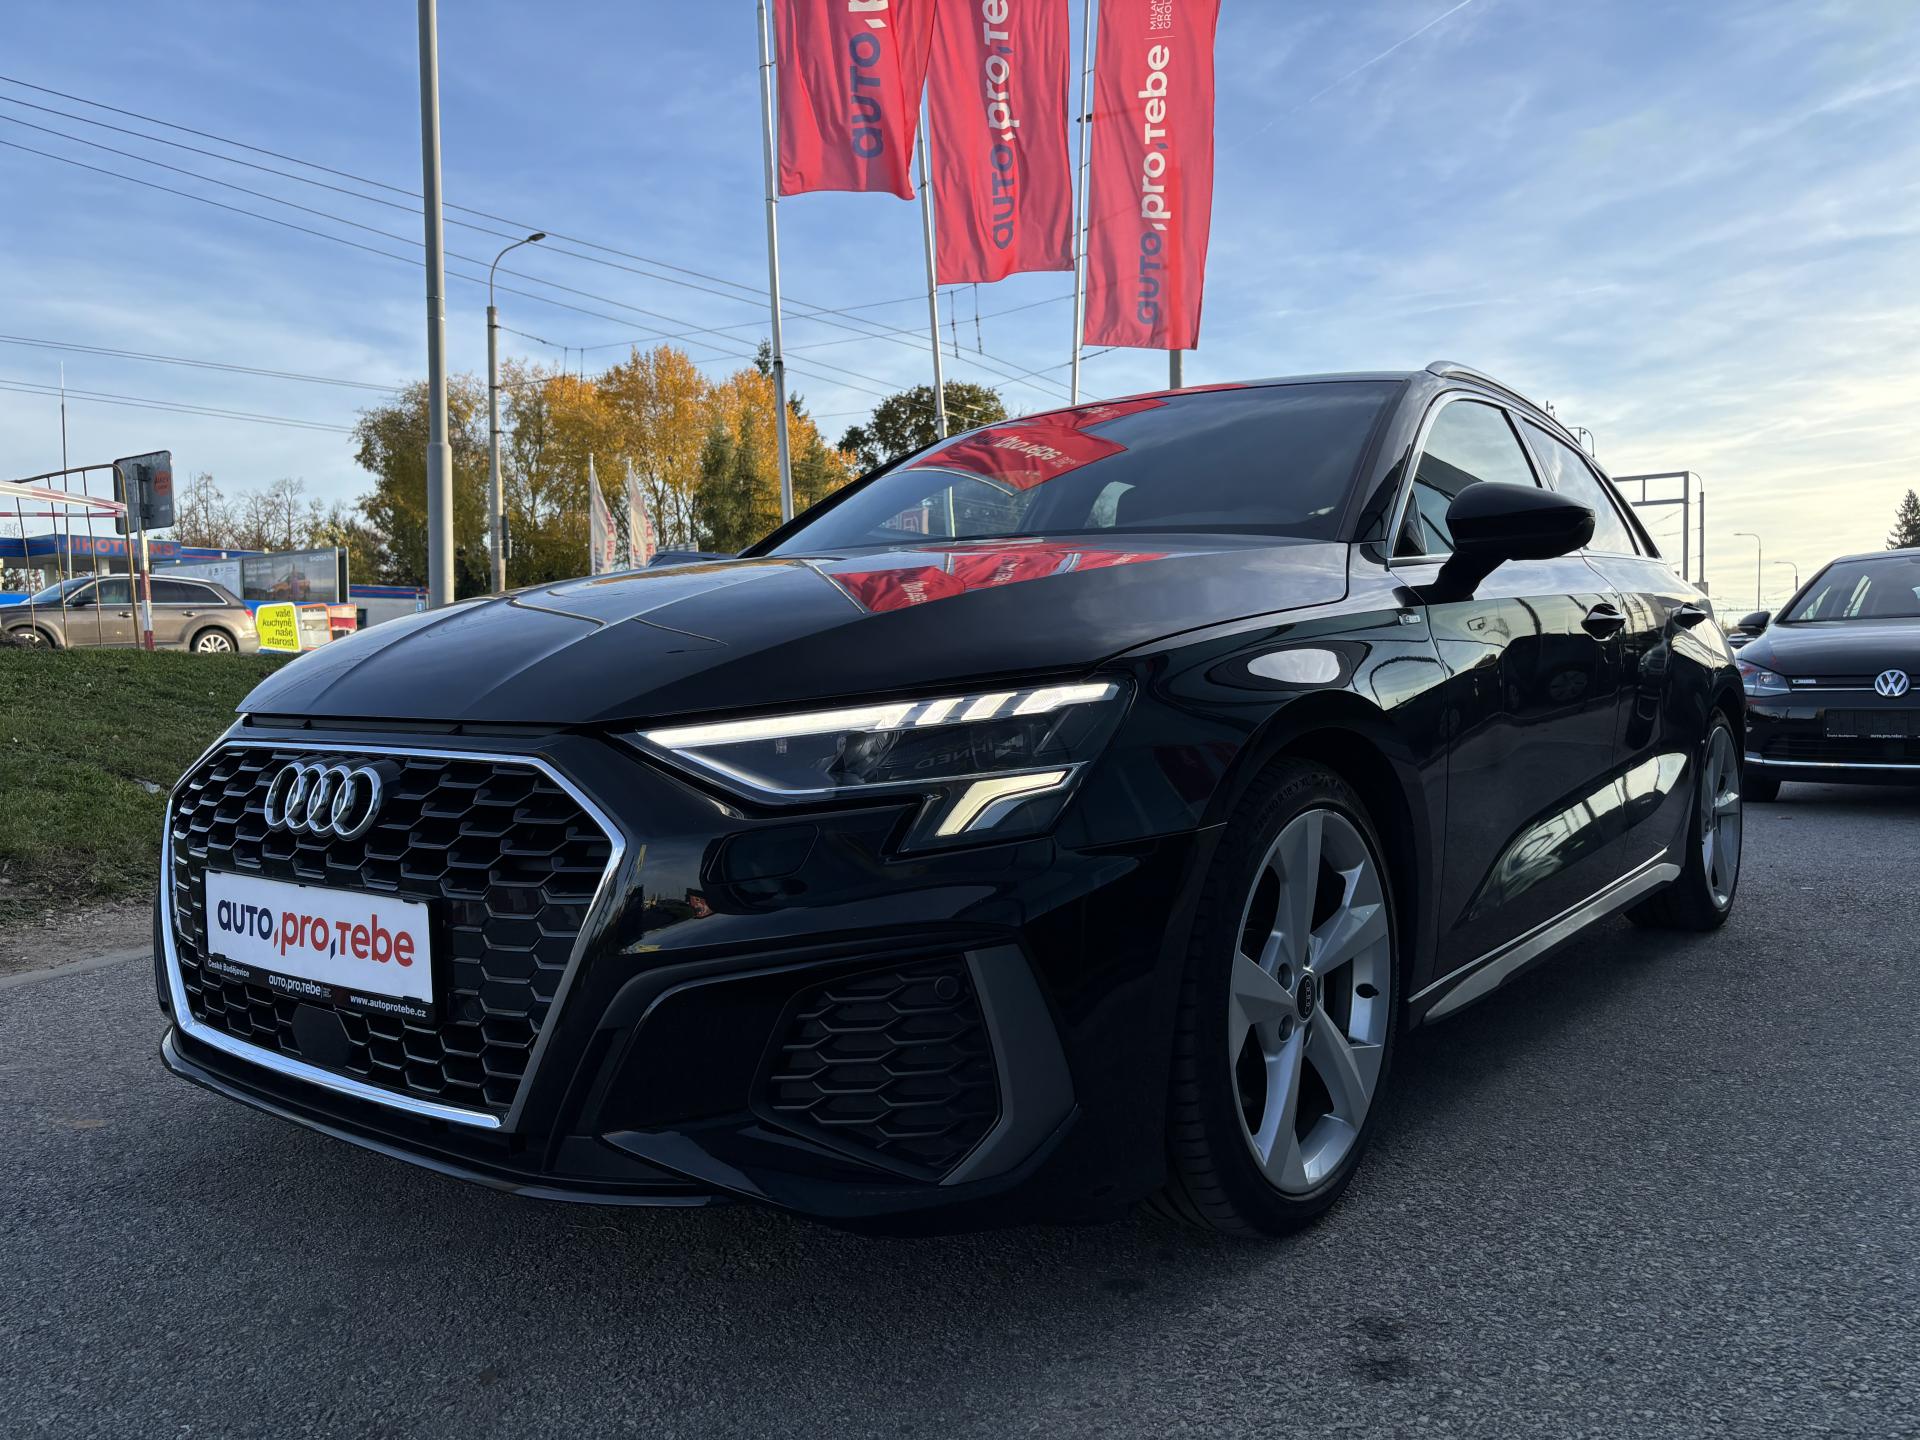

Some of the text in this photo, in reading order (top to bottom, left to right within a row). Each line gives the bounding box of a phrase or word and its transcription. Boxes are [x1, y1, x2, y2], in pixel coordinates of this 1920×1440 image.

[276, 608, 291, 617] vaše
[262, 618, 292, 628] kuchyně
[275, 628, 293, 637] naše
[267, 637, 294, 646] starost
[349, 995, 427, 1018] www.autoprotebe.cz
